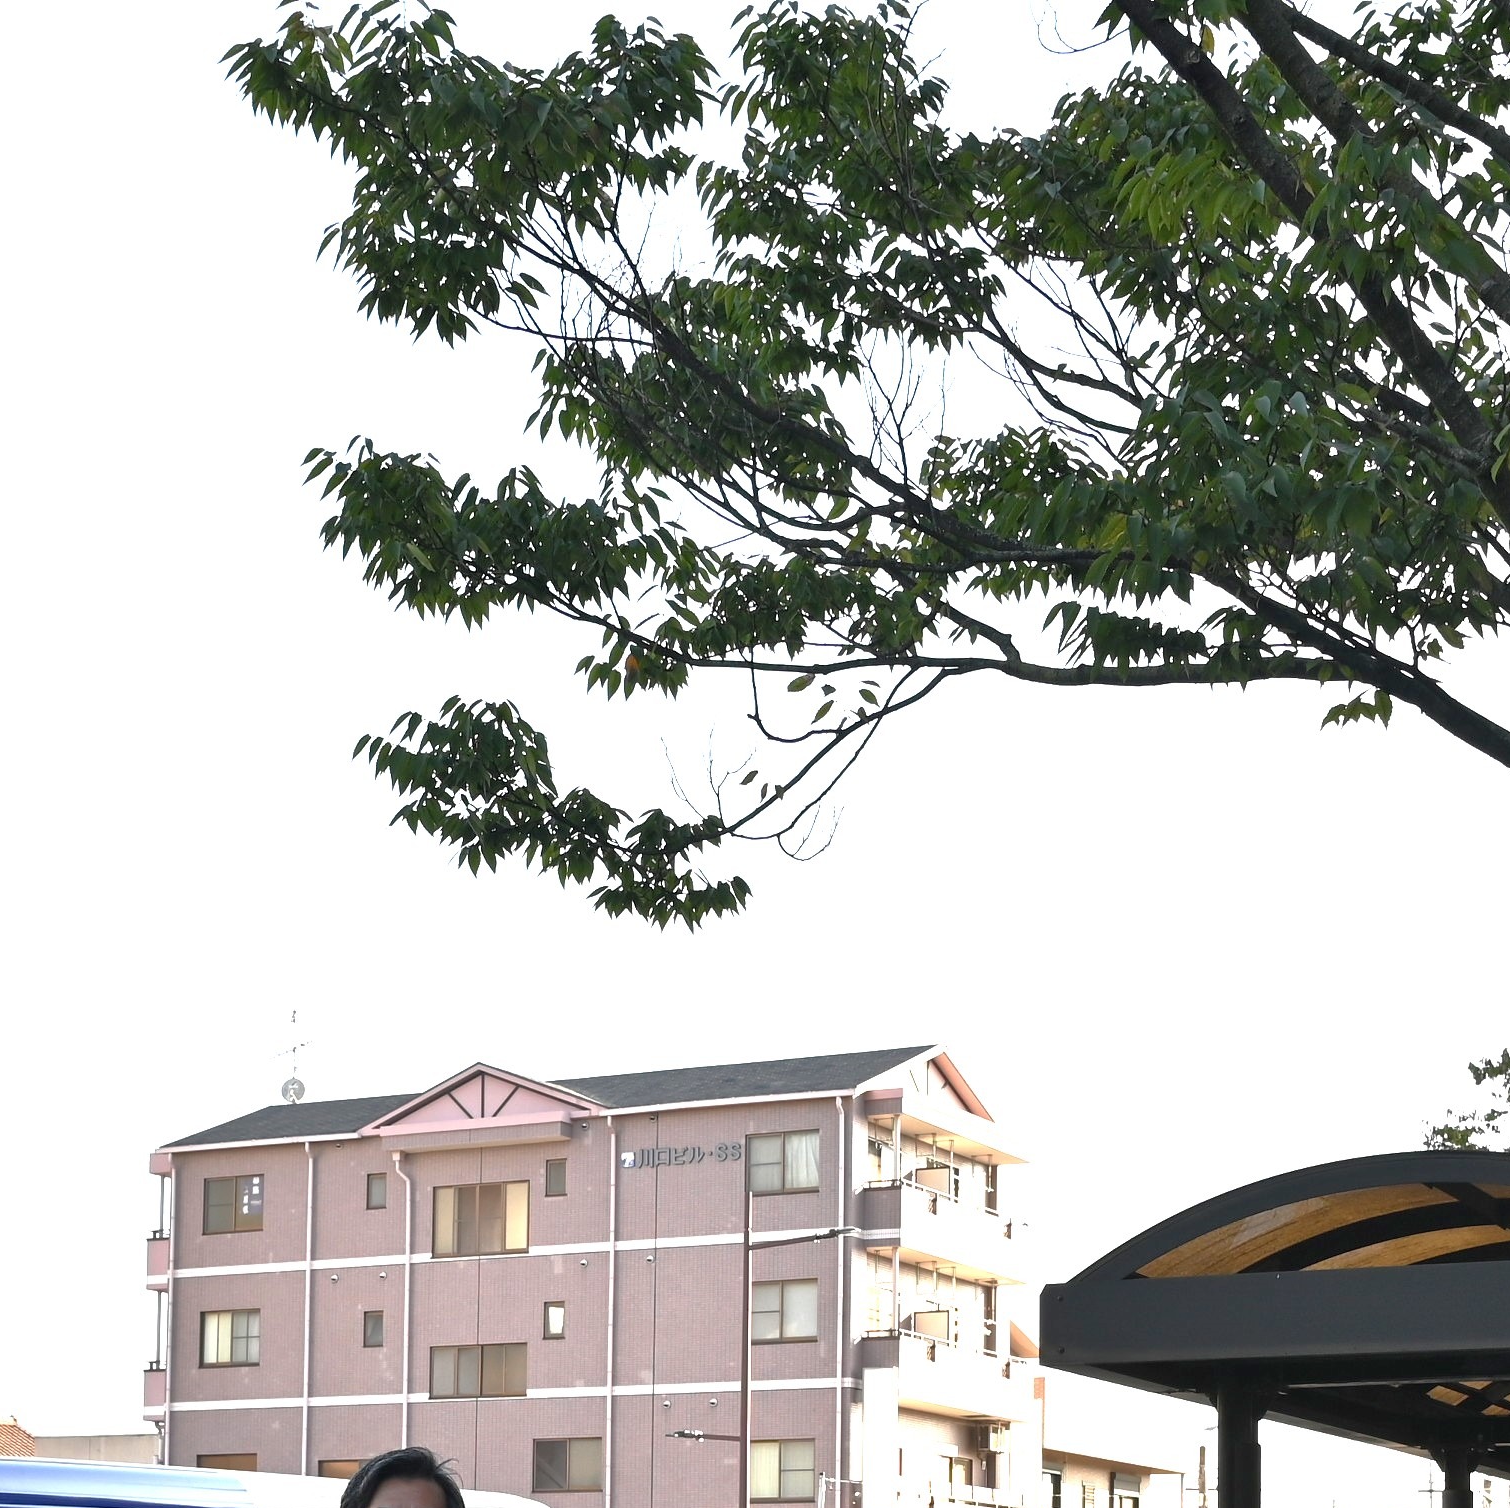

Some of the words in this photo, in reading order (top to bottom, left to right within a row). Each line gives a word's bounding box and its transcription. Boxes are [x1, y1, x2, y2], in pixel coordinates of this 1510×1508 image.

[638, 1142, 742, 1168] 川口ビル・SS
